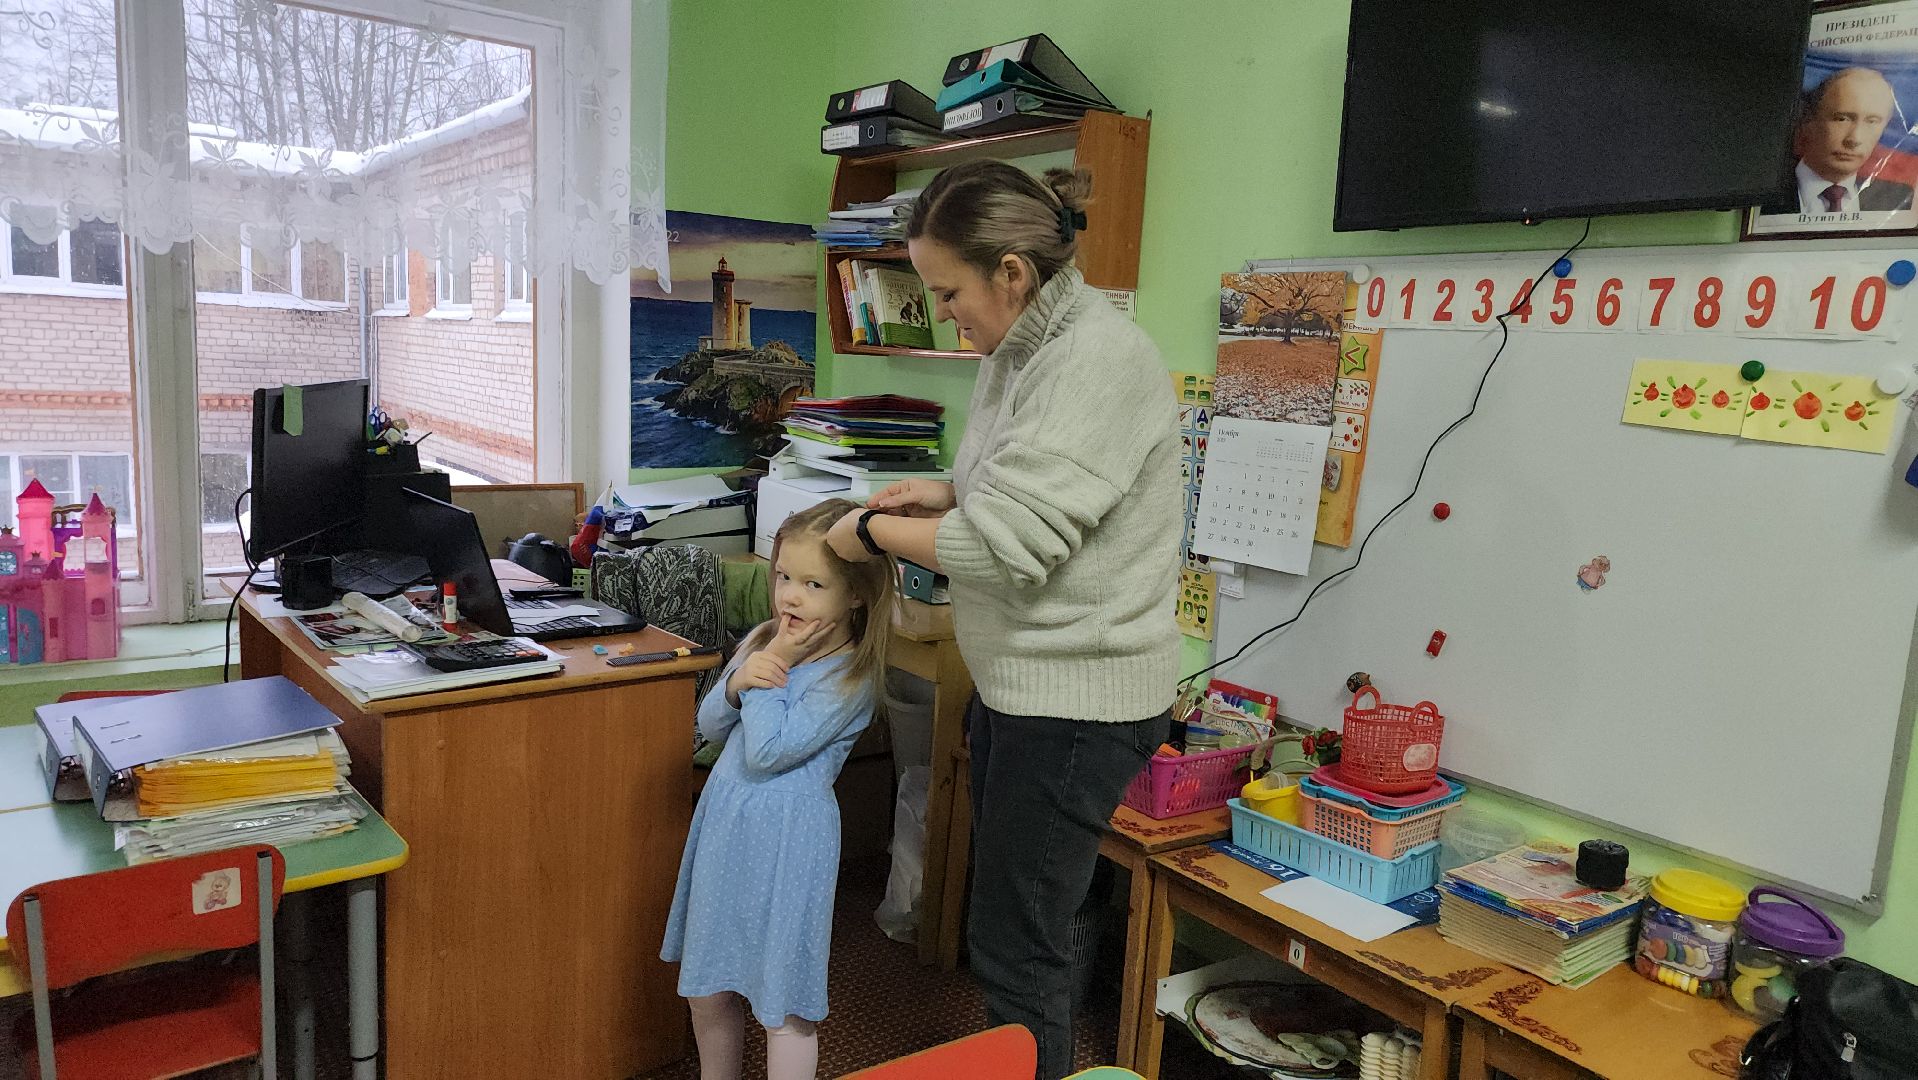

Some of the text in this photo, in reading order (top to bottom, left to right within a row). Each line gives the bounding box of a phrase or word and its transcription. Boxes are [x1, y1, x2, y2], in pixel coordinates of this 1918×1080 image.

[1826, 14, 1897, 32] ПРЕЗИДЕНТ
[1798, 214, 1835, 223] Путин
[1367, 277, 1386, 317] 0
[1400, 279, 1416, 320] 1
[1433, 279, 1455, 321] 2
[1472, 279, 1495, 323] 3
[1508, 279, 1535, 323] 4
[1550, 279, 1576, 324] 5
[1596, 279, 1623, 326] 6
[1649, 278, 1675, 327] 7
[1694, 277, 1723, 328] 8
[1745, 276, 1777, 329] 9
